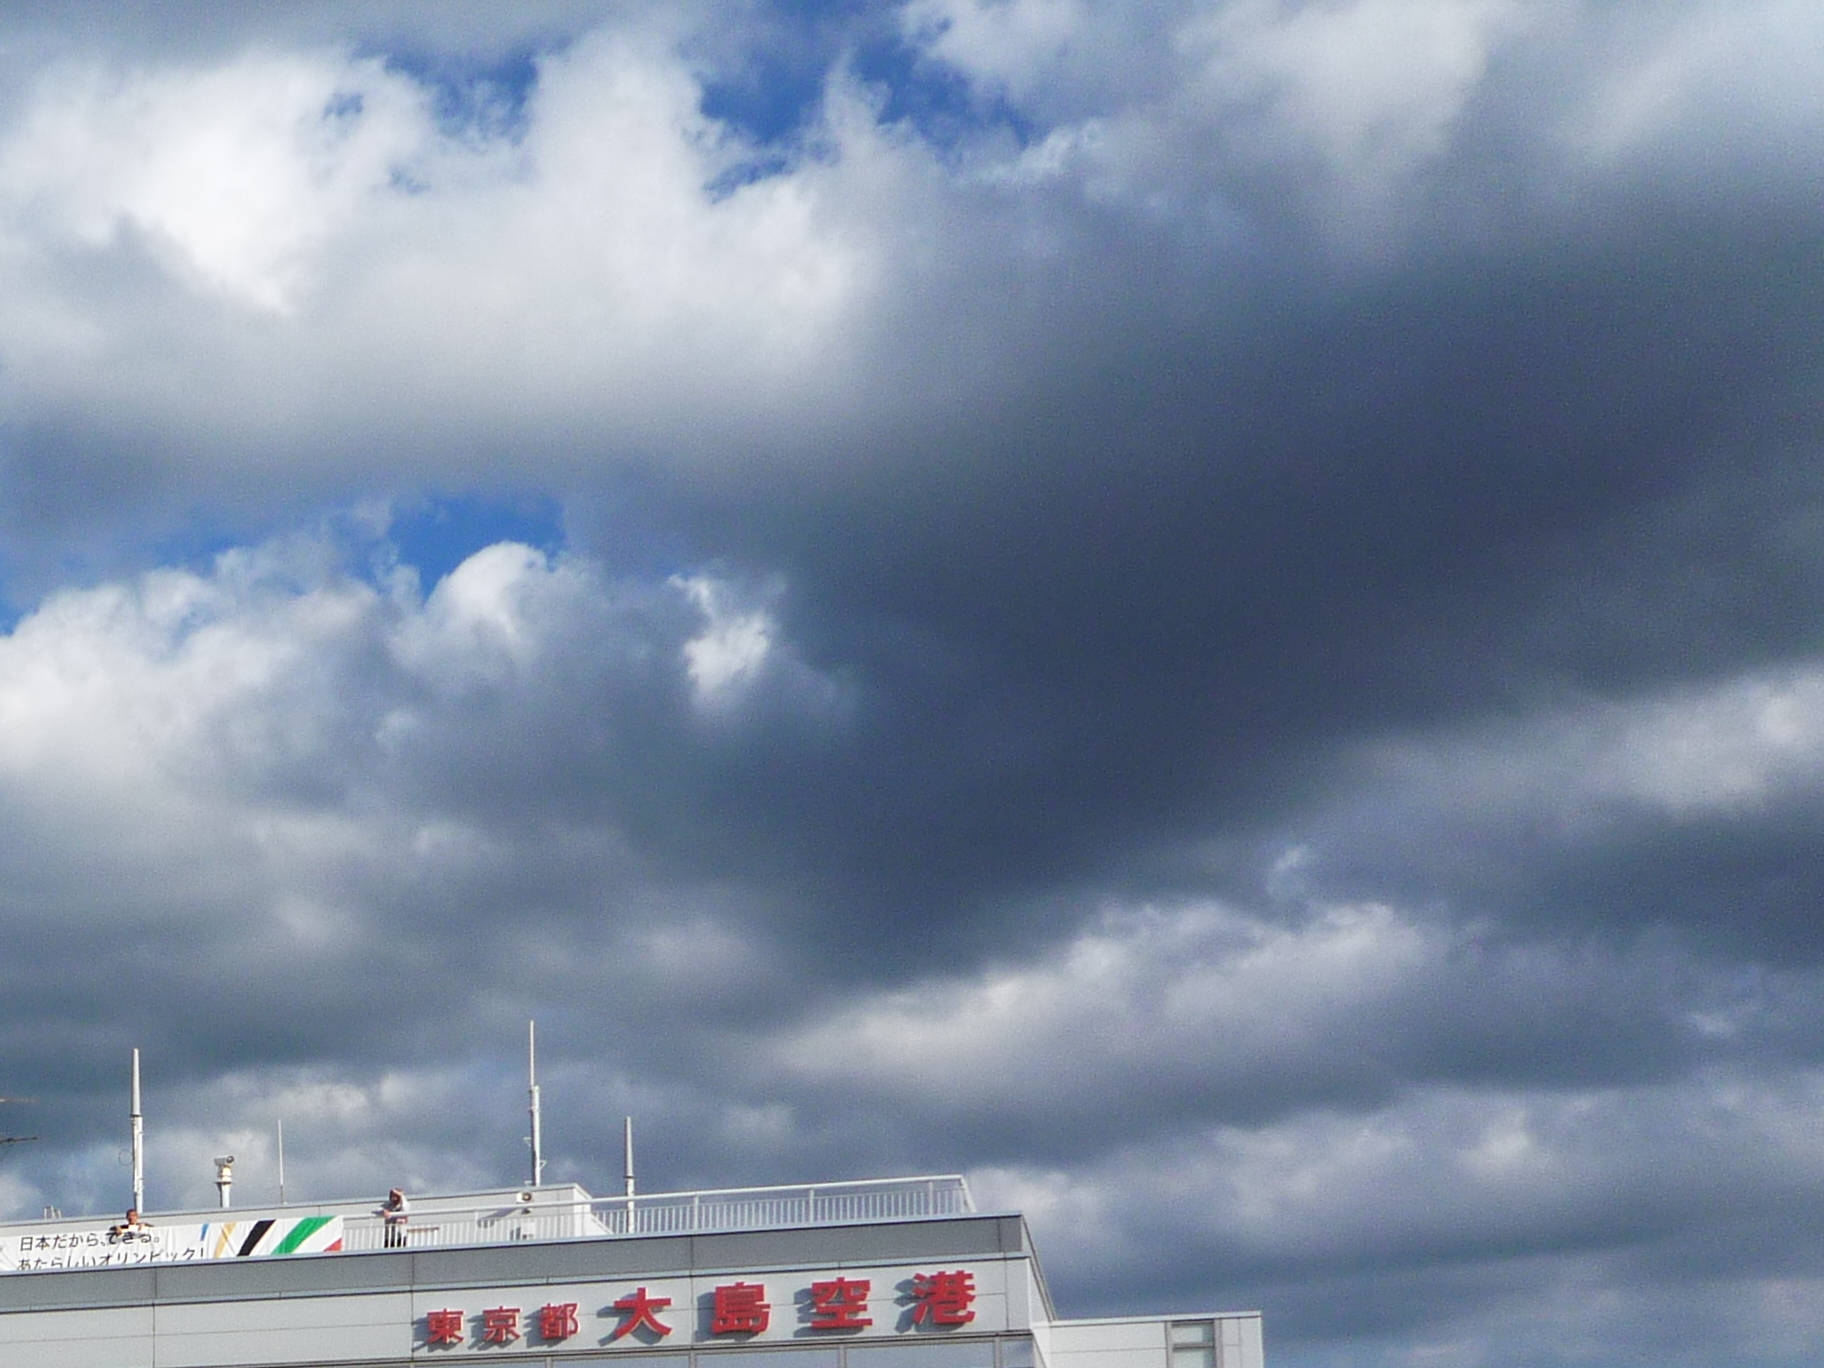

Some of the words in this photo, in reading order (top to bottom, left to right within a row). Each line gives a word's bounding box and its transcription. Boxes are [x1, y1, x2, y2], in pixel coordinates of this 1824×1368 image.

[426, 1303, 580, 1344] 東京都
[613, 1269, 977, 1339] 大島空港
